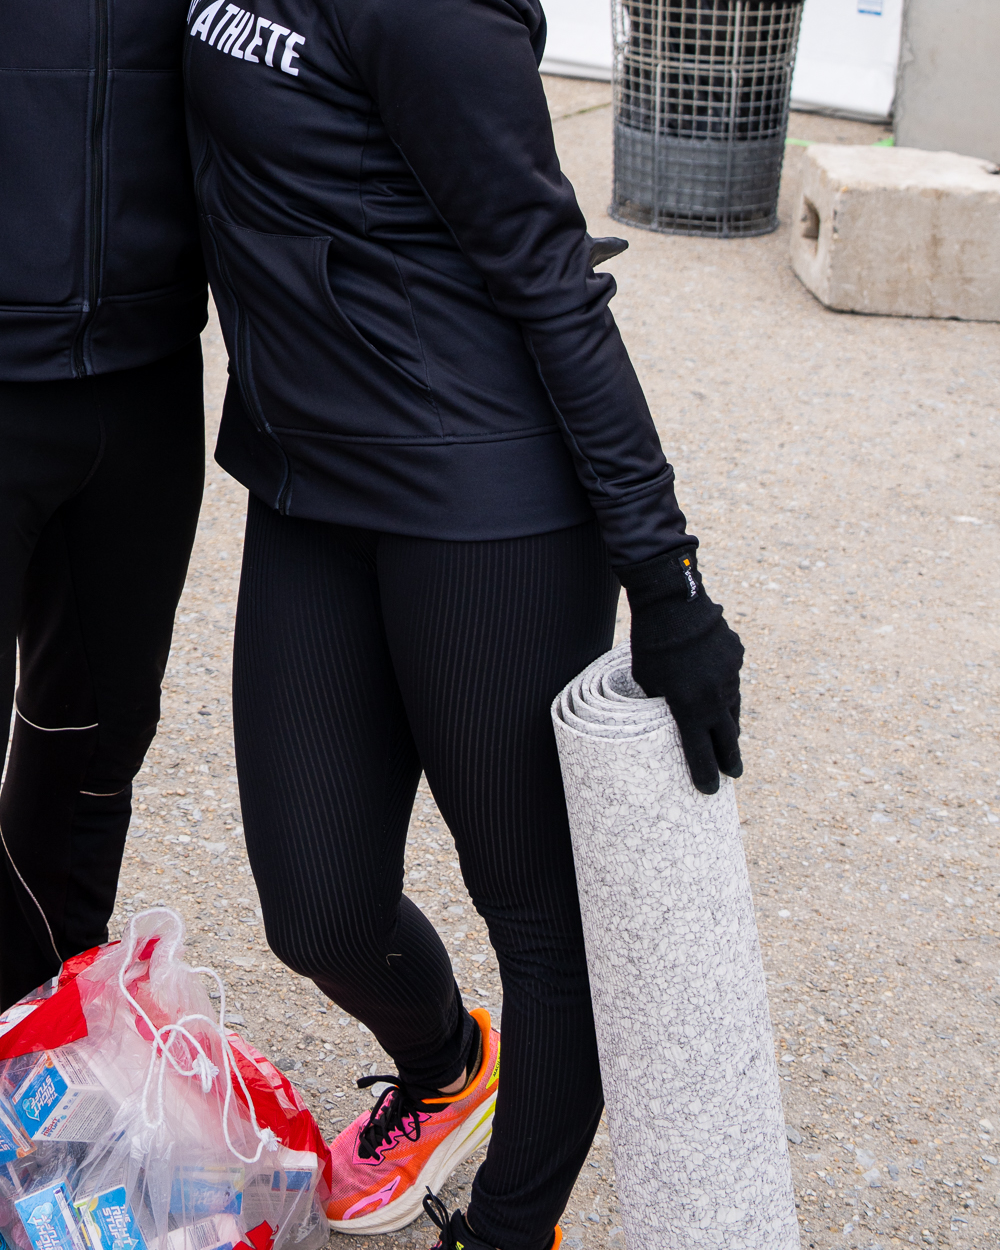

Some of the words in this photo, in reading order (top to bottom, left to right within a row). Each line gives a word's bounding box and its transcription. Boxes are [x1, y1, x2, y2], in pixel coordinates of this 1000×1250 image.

[29, 1074, 53, 1110] STUFF
[32, 1083, 57, 1118] RIGHT
[46, 1091, 59, 1107] THE
[101, 1207, 125, 1248] STUFF
[110, 1205, 134, 1246] RIGHT
